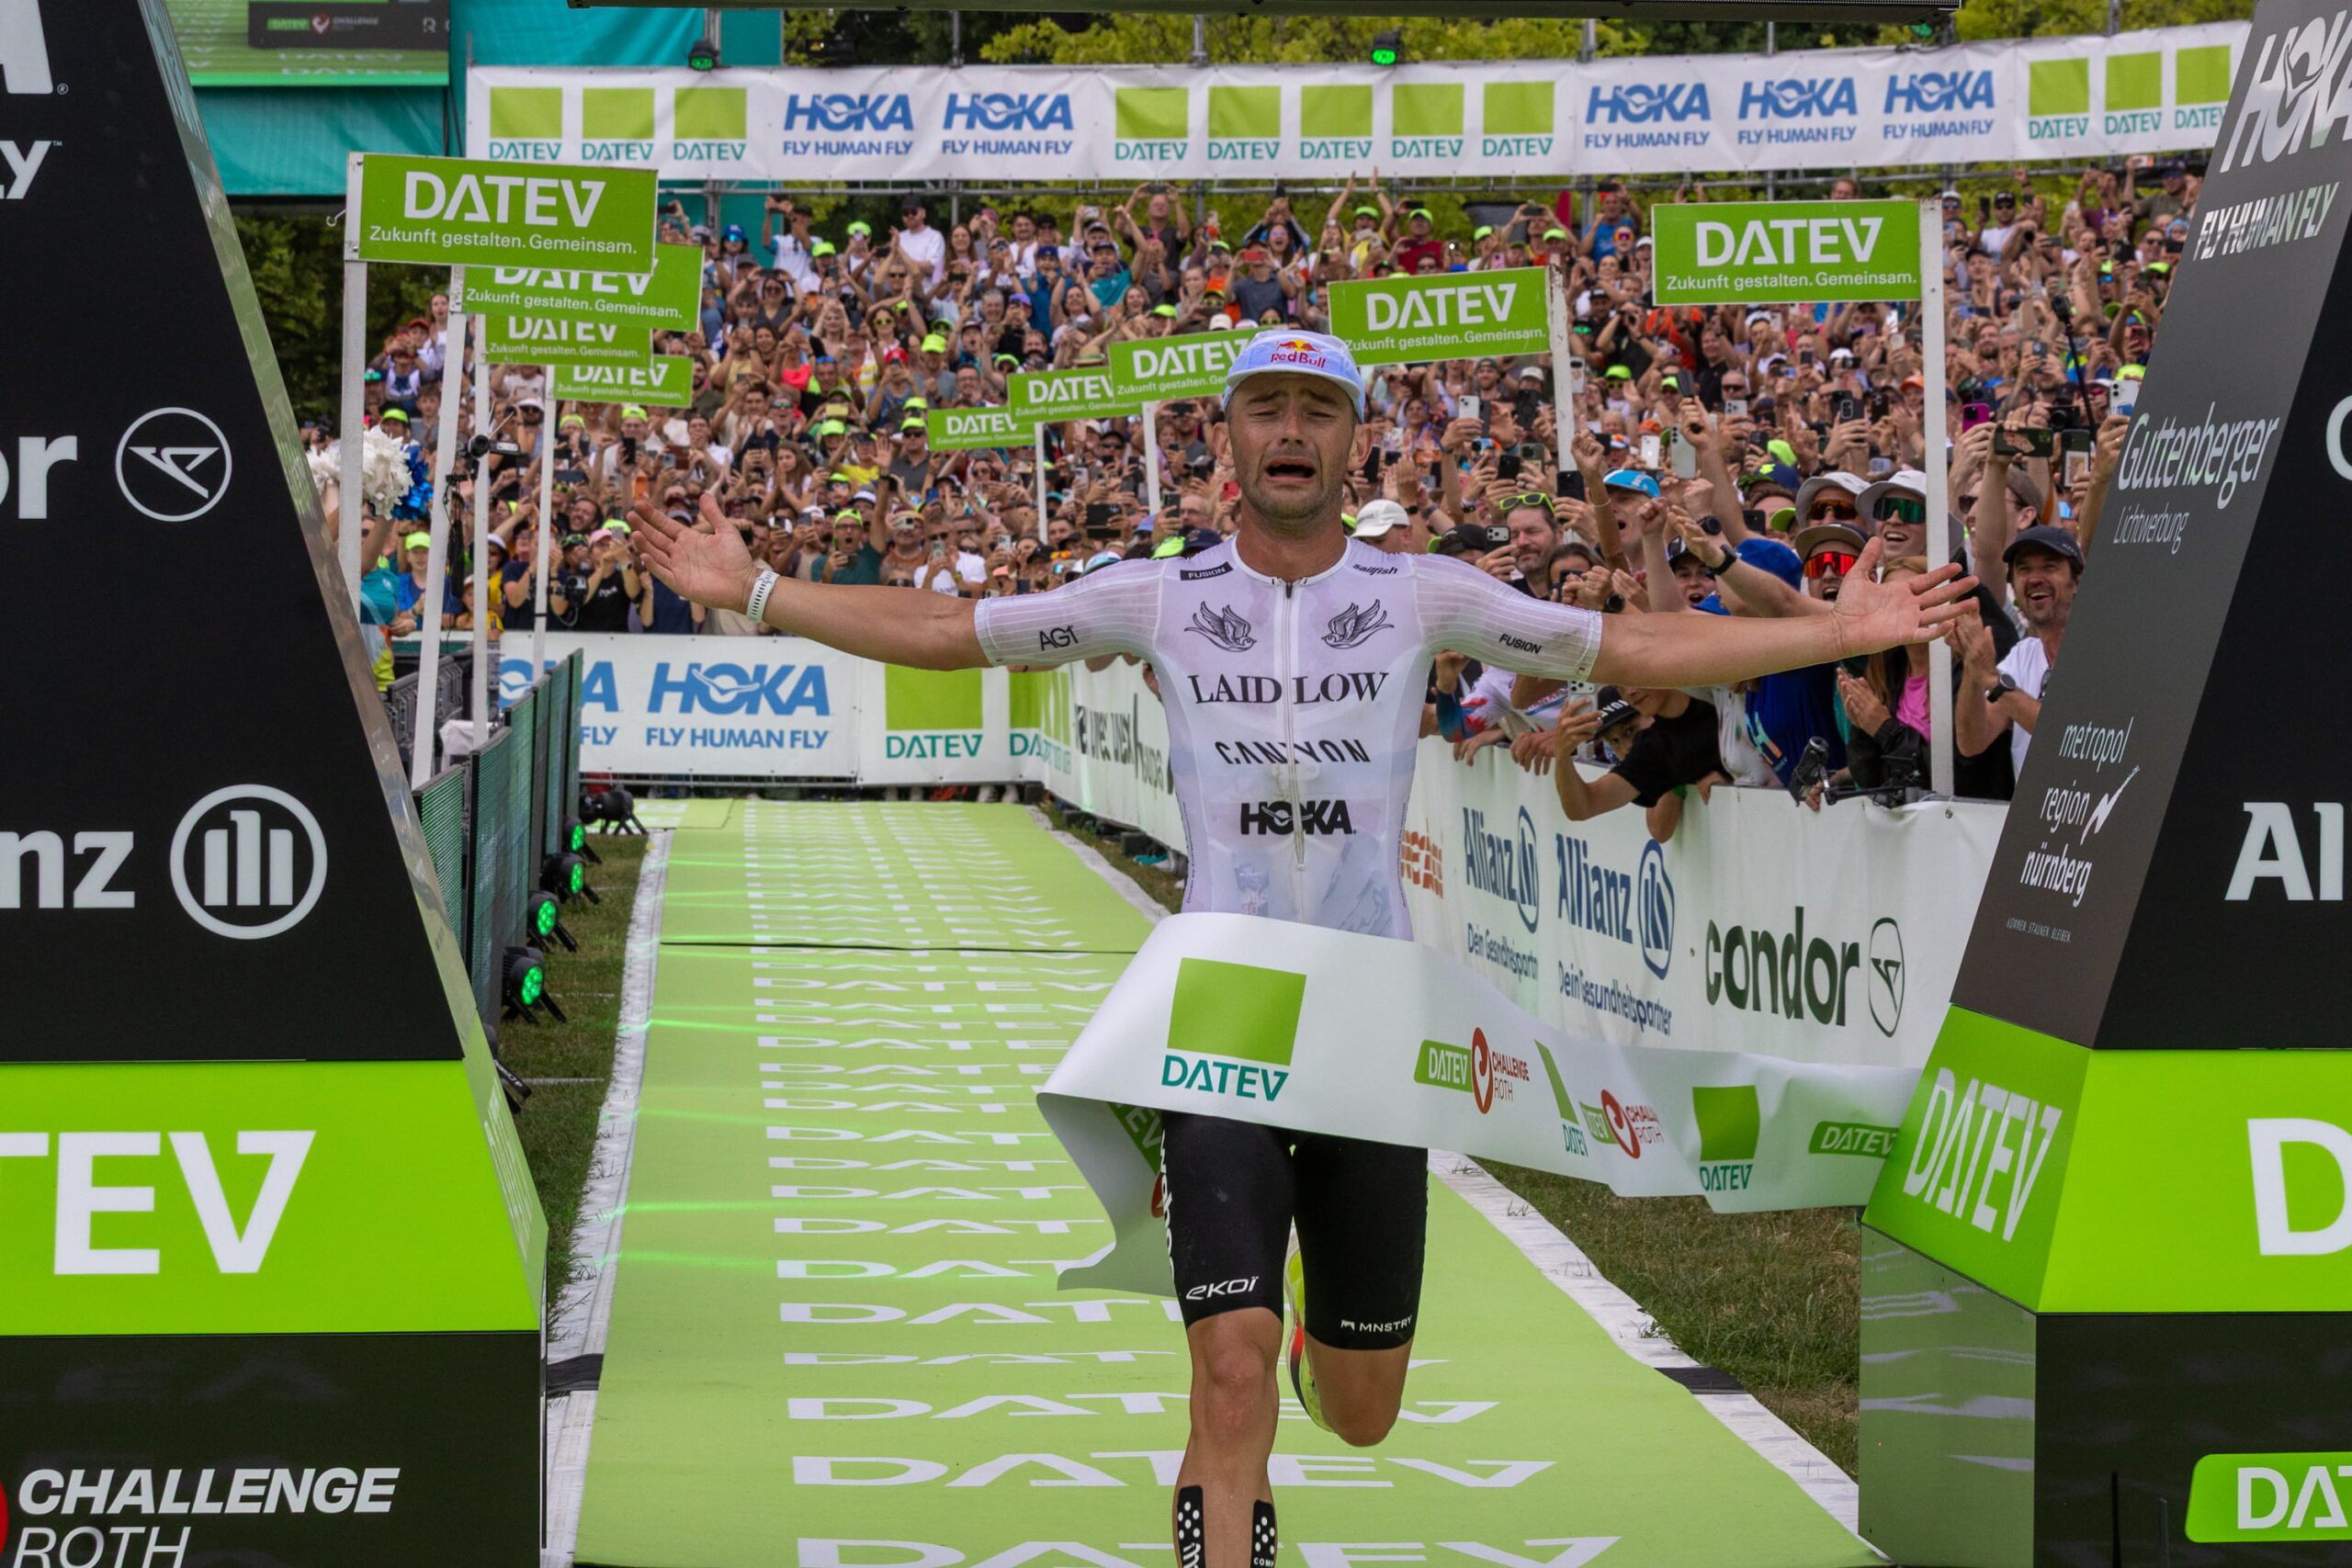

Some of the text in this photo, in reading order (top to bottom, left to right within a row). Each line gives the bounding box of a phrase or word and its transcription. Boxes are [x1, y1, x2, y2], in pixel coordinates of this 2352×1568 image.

[1585, 83, 1711, 124] HOKA
[1738, 77, 1858, 120] HOKA
[1883, 70, 1995, 114] HOKA
[784, 94, 914, 131] HOKA
[943, 93, 1074, 130] HOKA
[2104, 113, 2162, 135] DATEV
[1585, 130, 1710, 149] FLY HUMAN FLY
[1738, 126, 1857, 144] FLY HUMAN FLY
[1883, 118, 1995, 140] FLY HUMAN FLY
[2029, 117, 2089, 140] DATEV
[489, 142, 562, 161] DATEV
[582, 142, 654, 161] DATEV
[673, 142, 746, 161] DATEV
[783, 141, 914, 155] FLY HUMAN FLY
[942, 140, 1073, 154] FLY HUMAN FLY
[1114, 141, 1188, 160] DATEV
[1208, 141, 1280, 160] DATEV
[1300, 141, 1373, 159] DATEV
[1392, 139, 1464, 158] DATEV
[1482, 138, 1554, 157] DATEV
[404, 171, 606, 228] DATEV
[2193, 182, 2341, 261] FLY HUMAN FLY
[369, 225, 638, 255] Zukunft gestalten. Gemeinsam.
[1696, 217, 1883, 266] DATEV
[1667, 271, 1917, 291] Zukunft gestalten. Gemeinsam.
[467, 288, 683, 319] Zukunft gestalten. Gemeinsam.
[1366, 283, 1516, 332] DATEV
[490, 343, 640, 359] Zukunft gestalten. Gemeinsam.
[1345, 328, 1546, 353] Zukunft gestalten. Gemeinsam.
[1271, 351, 1326, 368] Red Bull
[1117, 383, 1156, 396] Zukunft
[1159, 378, 1206, 392] gestalten.
[2117, 400, 2280, 510] Guttenberger
[2113, 502, 2189, 555] Lichtwerbung
[1188, 566, 1226, 580] FUSION
[1352, 563, 1398, 576] sailfish
[1039, 625, 1080, 651] AG1
[1498, 633, 1543, 655] FUSION
[648, 662, 831, 716] HOKA
[581, 727, 618, 745] FLY
[646, 727, 829, 749] FLY HUMAN FLY
[886, 734, 982, 759] DATEV
[2058, 716, 2134, 773] metropol
[1215, 739, 1371, 765] CANYON
[1240, 800, 1353, 835] HOKA
[2040, 780, 2090, 833] region
[1464, 807, 1516, 903] Allianz
[2020, 842, 2093, 908] nürnberg
[1556, 833, 1633, 944] Allianz
[1467, 923, 1484, 959] Dein
[1705, 906, 1860, 1027] condor
[1558, 960, 1673, 1037] Dein Gesundheitspartner
[757, 1035, 1069, 1050] DATE
[759, 1063, 1058, 1076] DATE
[1161, 1055, 1289, 1101] DATEV
[1428, 1047, 1530, 1086] DATEV CHALLENGE
[762, 1080, 1042, 1094] DAT
[1494, 1077, 1514, 1101] ROTH
[763, 1098, 1035, 1113] DAT
[765, 1125, 1051, 1145] DAT
[1562, 1123, 1589, 1157] DATEV
[1821, 1126, 1896, 1155] DATEV
[768, 1156, 1068, 1172] DAT
[1903, 1066, 2063, 1243] DATEV
[1700, 1164, 1753, 1192] DATEV
[771, 1185, 1086, 1200] DAT
[774, 1217, 1105, 1234] DAT
[780, 1299, 1183, 1324] DAT
[1359, 1314, 1412, 1332] MNSTRY
[17, 1468, 401, 1515] CHALLENGE
[13, 1527, 191, 1568] ROTH
